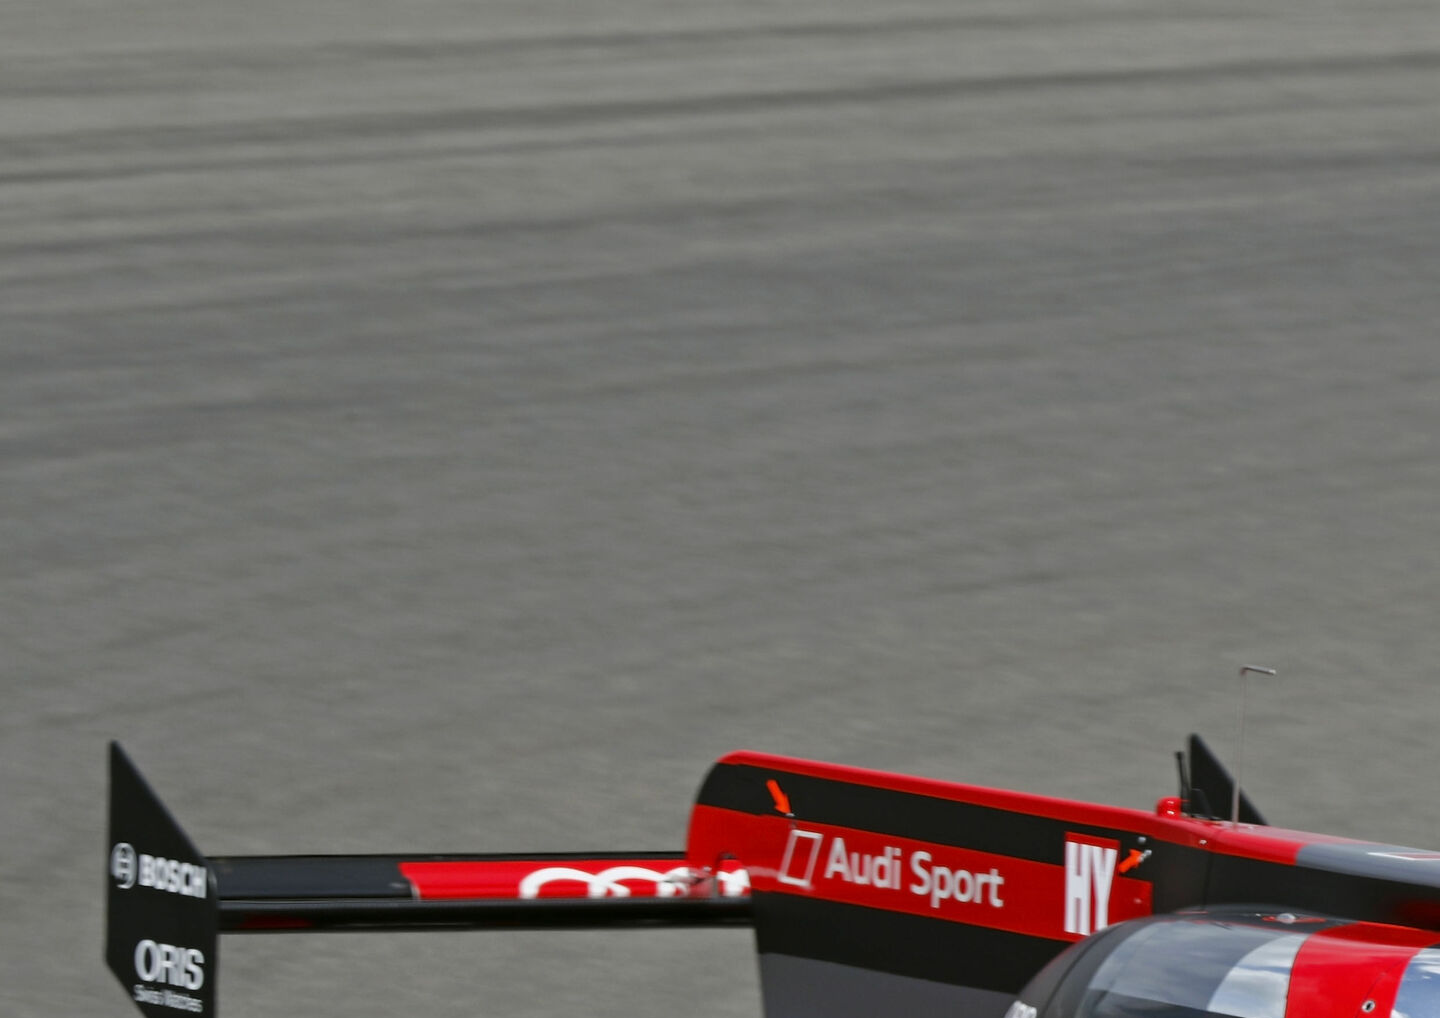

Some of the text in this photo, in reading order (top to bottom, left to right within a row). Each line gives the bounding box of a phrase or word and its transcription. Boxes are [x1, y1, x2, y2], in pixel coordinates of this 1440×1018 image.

[138, 853, 208, 899] BOSCH
[824, 837, 1004, 909] Audi Sport
[1064, 840, 1118, 937] HY
[134, 939, 206, 991] ORIS
